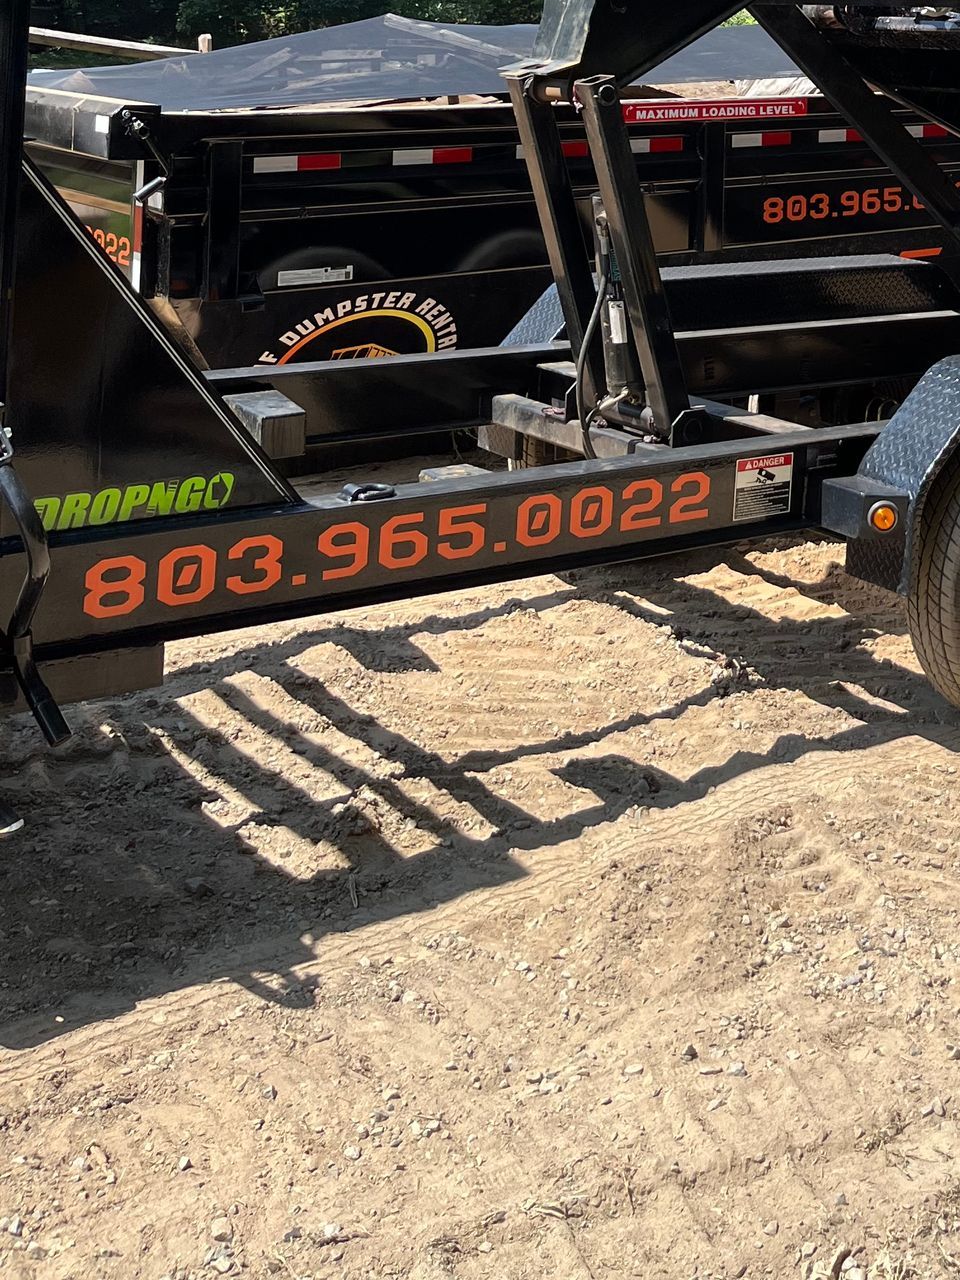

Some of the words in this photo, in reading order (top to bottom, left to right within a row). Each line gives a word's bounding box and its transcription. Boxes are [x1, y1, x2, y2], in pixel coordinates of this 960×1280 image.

[635, 107, 699, 120] MAXIMUM
[702, 106, 756, 118] LOADING
[759, 105, 796, 116] LEVEL
[278, 291, 417, 347] DUMPSTER
[753, 457, 785, 469] DANGER
[83, 471, 712, 619] 803.965.0022
